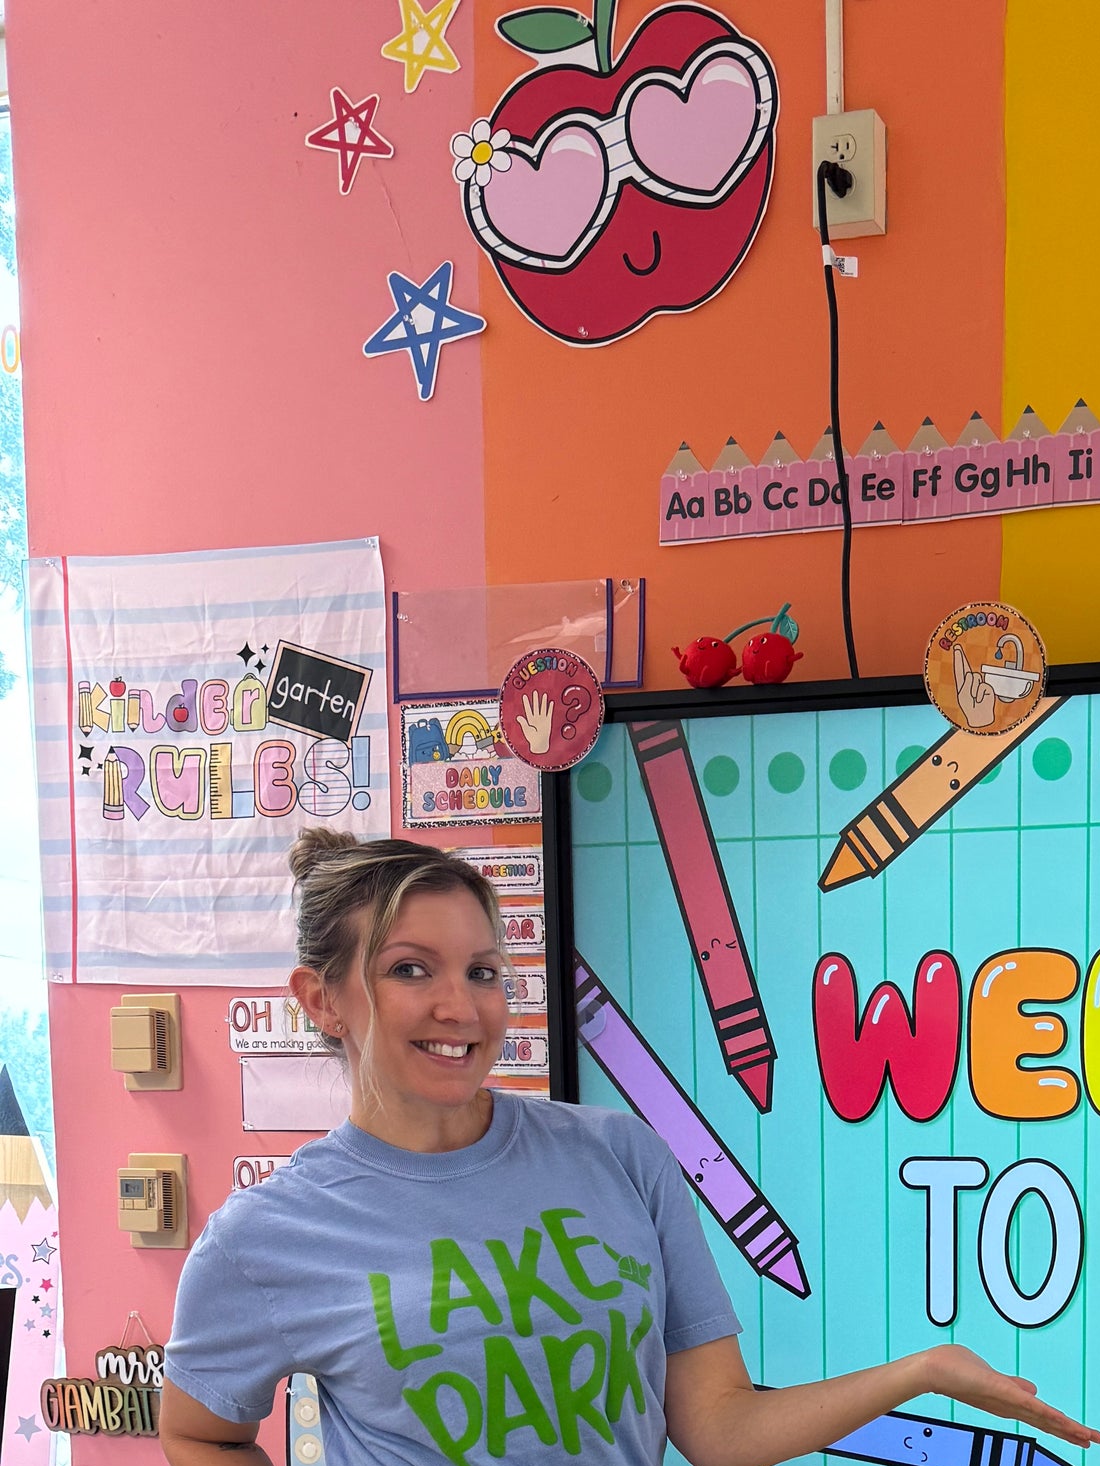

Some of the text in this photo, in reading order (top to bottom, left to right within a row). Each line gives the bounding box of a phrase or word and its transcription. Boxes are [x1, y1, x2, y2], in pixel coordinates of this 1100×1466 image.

[665, 492, 704, 520] Aa
[714, 486, 752, 517] Bb
[763, 482, 799, 511] Cc
[861, 474, 895, 500] Ee
[913, 466, 943, 498] Ff
[954, 463, 1000, 498] Gg
[1006, 453, 1050, 487] Hh
[1068, 449, 1093, 481] Ii
[939, 612, 1009, 651] RESTROOM
[512, 656, 578, 690] QUESTION
[271, 676, 355, 722] garten
[446, 765, 502, 788] DAILY
[422, 786, 527, 812] SCHEDULE
[482, 863, 535, 877] MEETING
[231, 1001, 272, 1032] OH
[235, 1039, 250, 1048] We
[271, 1039, 304, 1050] making
[236, 1160, 274, 1189] OH
[899, 1155, 1086, 1329] TO
[368, 1208, 624, 1370] LAKE
[41, 1384, 160, 1431] GIAMBAT
